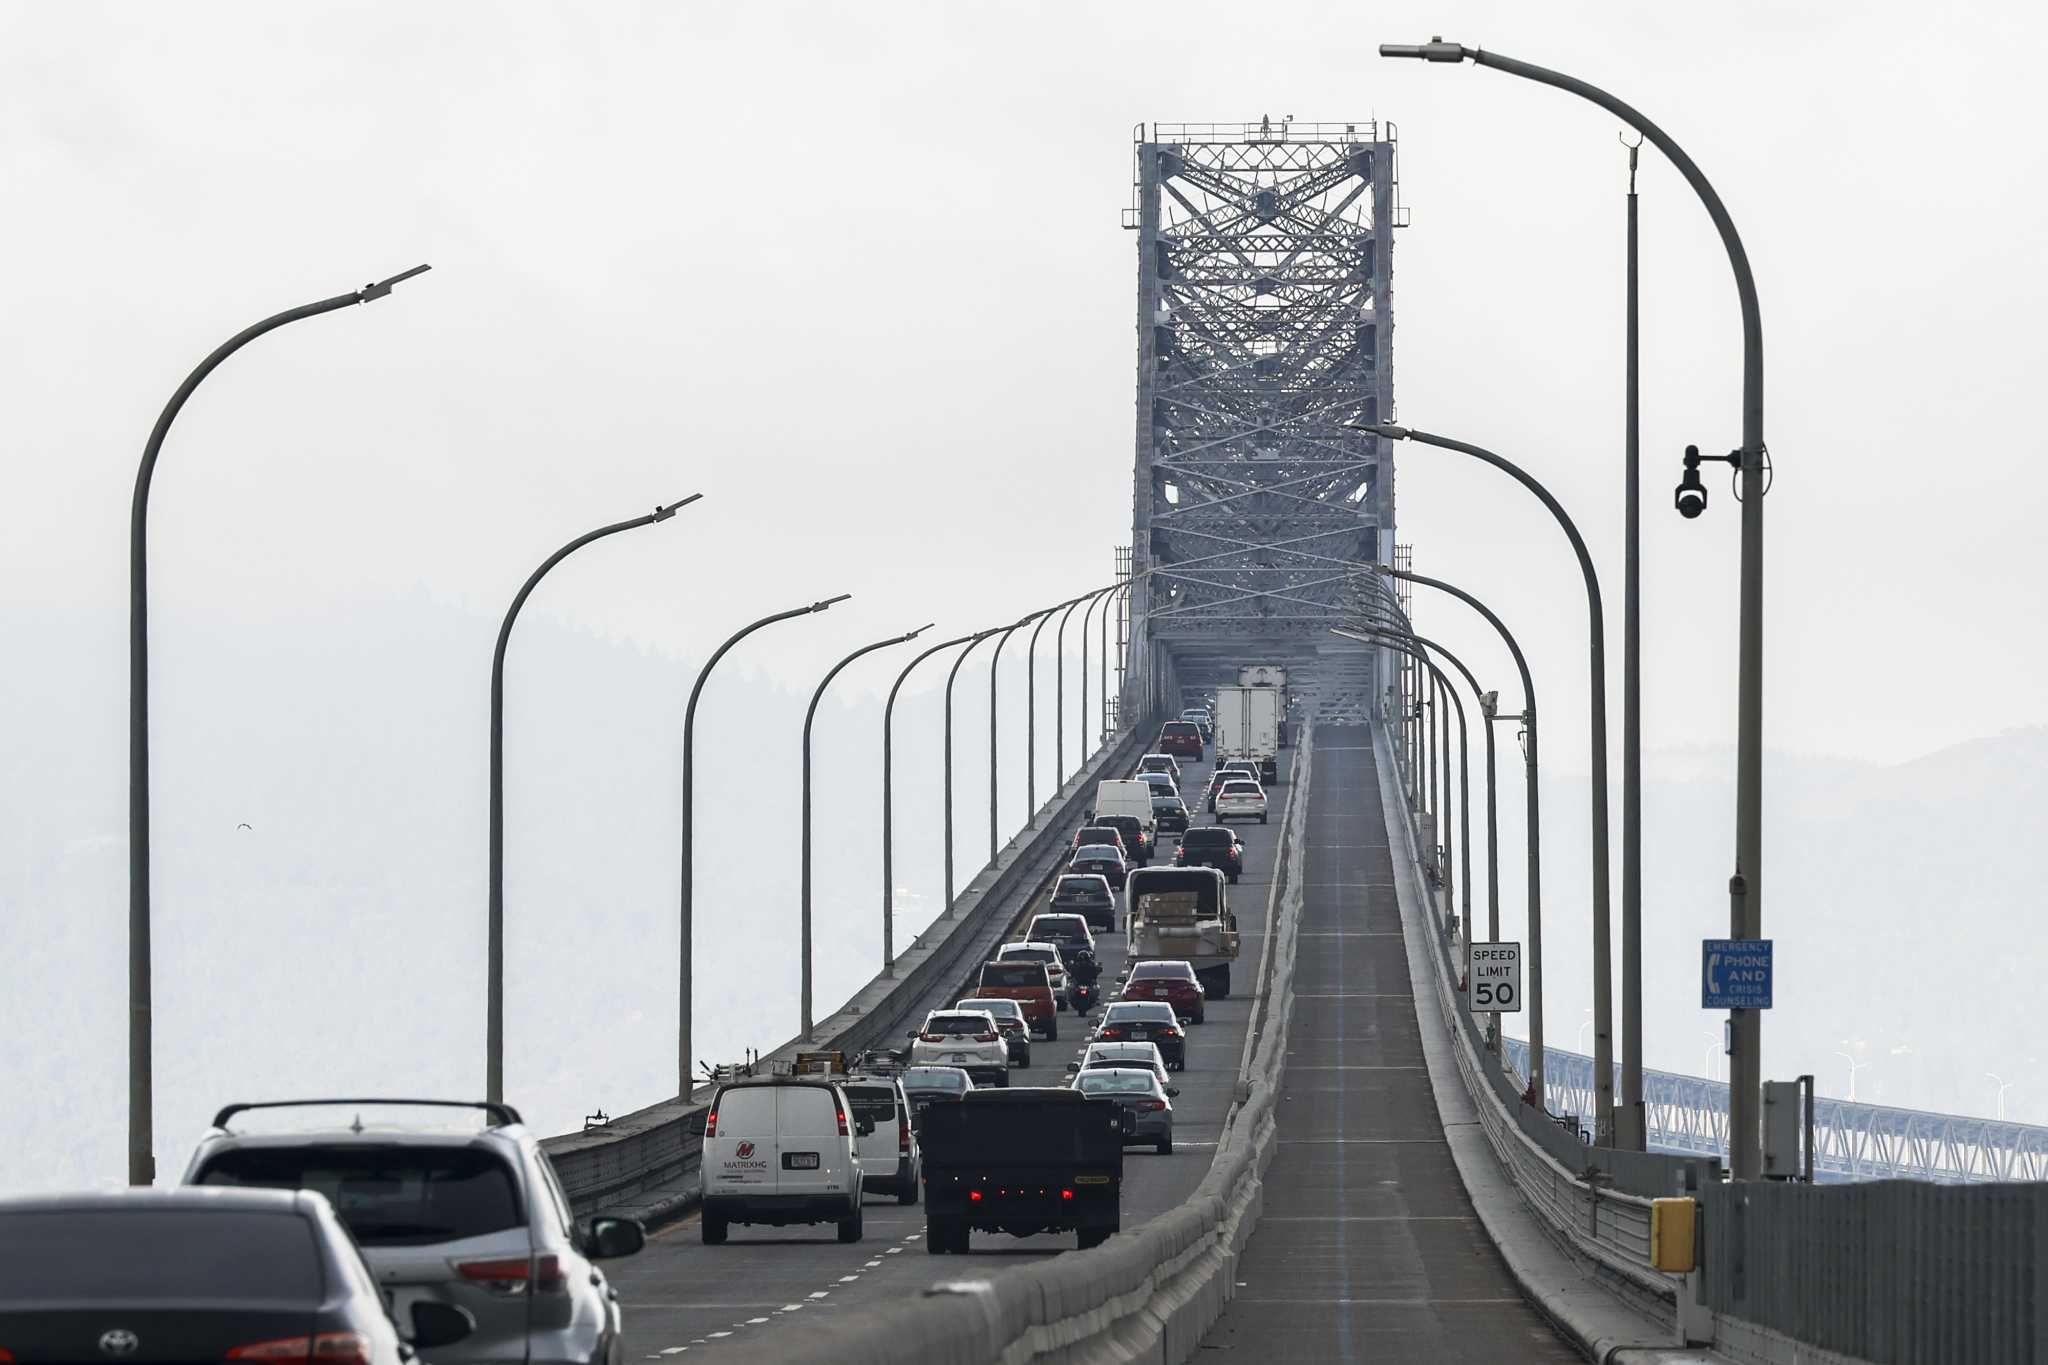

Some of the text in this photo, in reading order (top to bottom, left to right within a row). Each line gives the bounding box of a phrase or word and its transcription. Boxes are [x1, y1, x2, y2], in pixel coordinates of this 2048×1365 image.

[1706, 942, 1769, 952] EMERGENCY
[1473, 950, 1516, 960] SPEED
[1724, 956, 1769, 967] PHONE
[1477, 966, 1512, 977] LIMIT
[1728, 970, 1766, 982] AND
[1476, 982, 1514, 1005] 50
